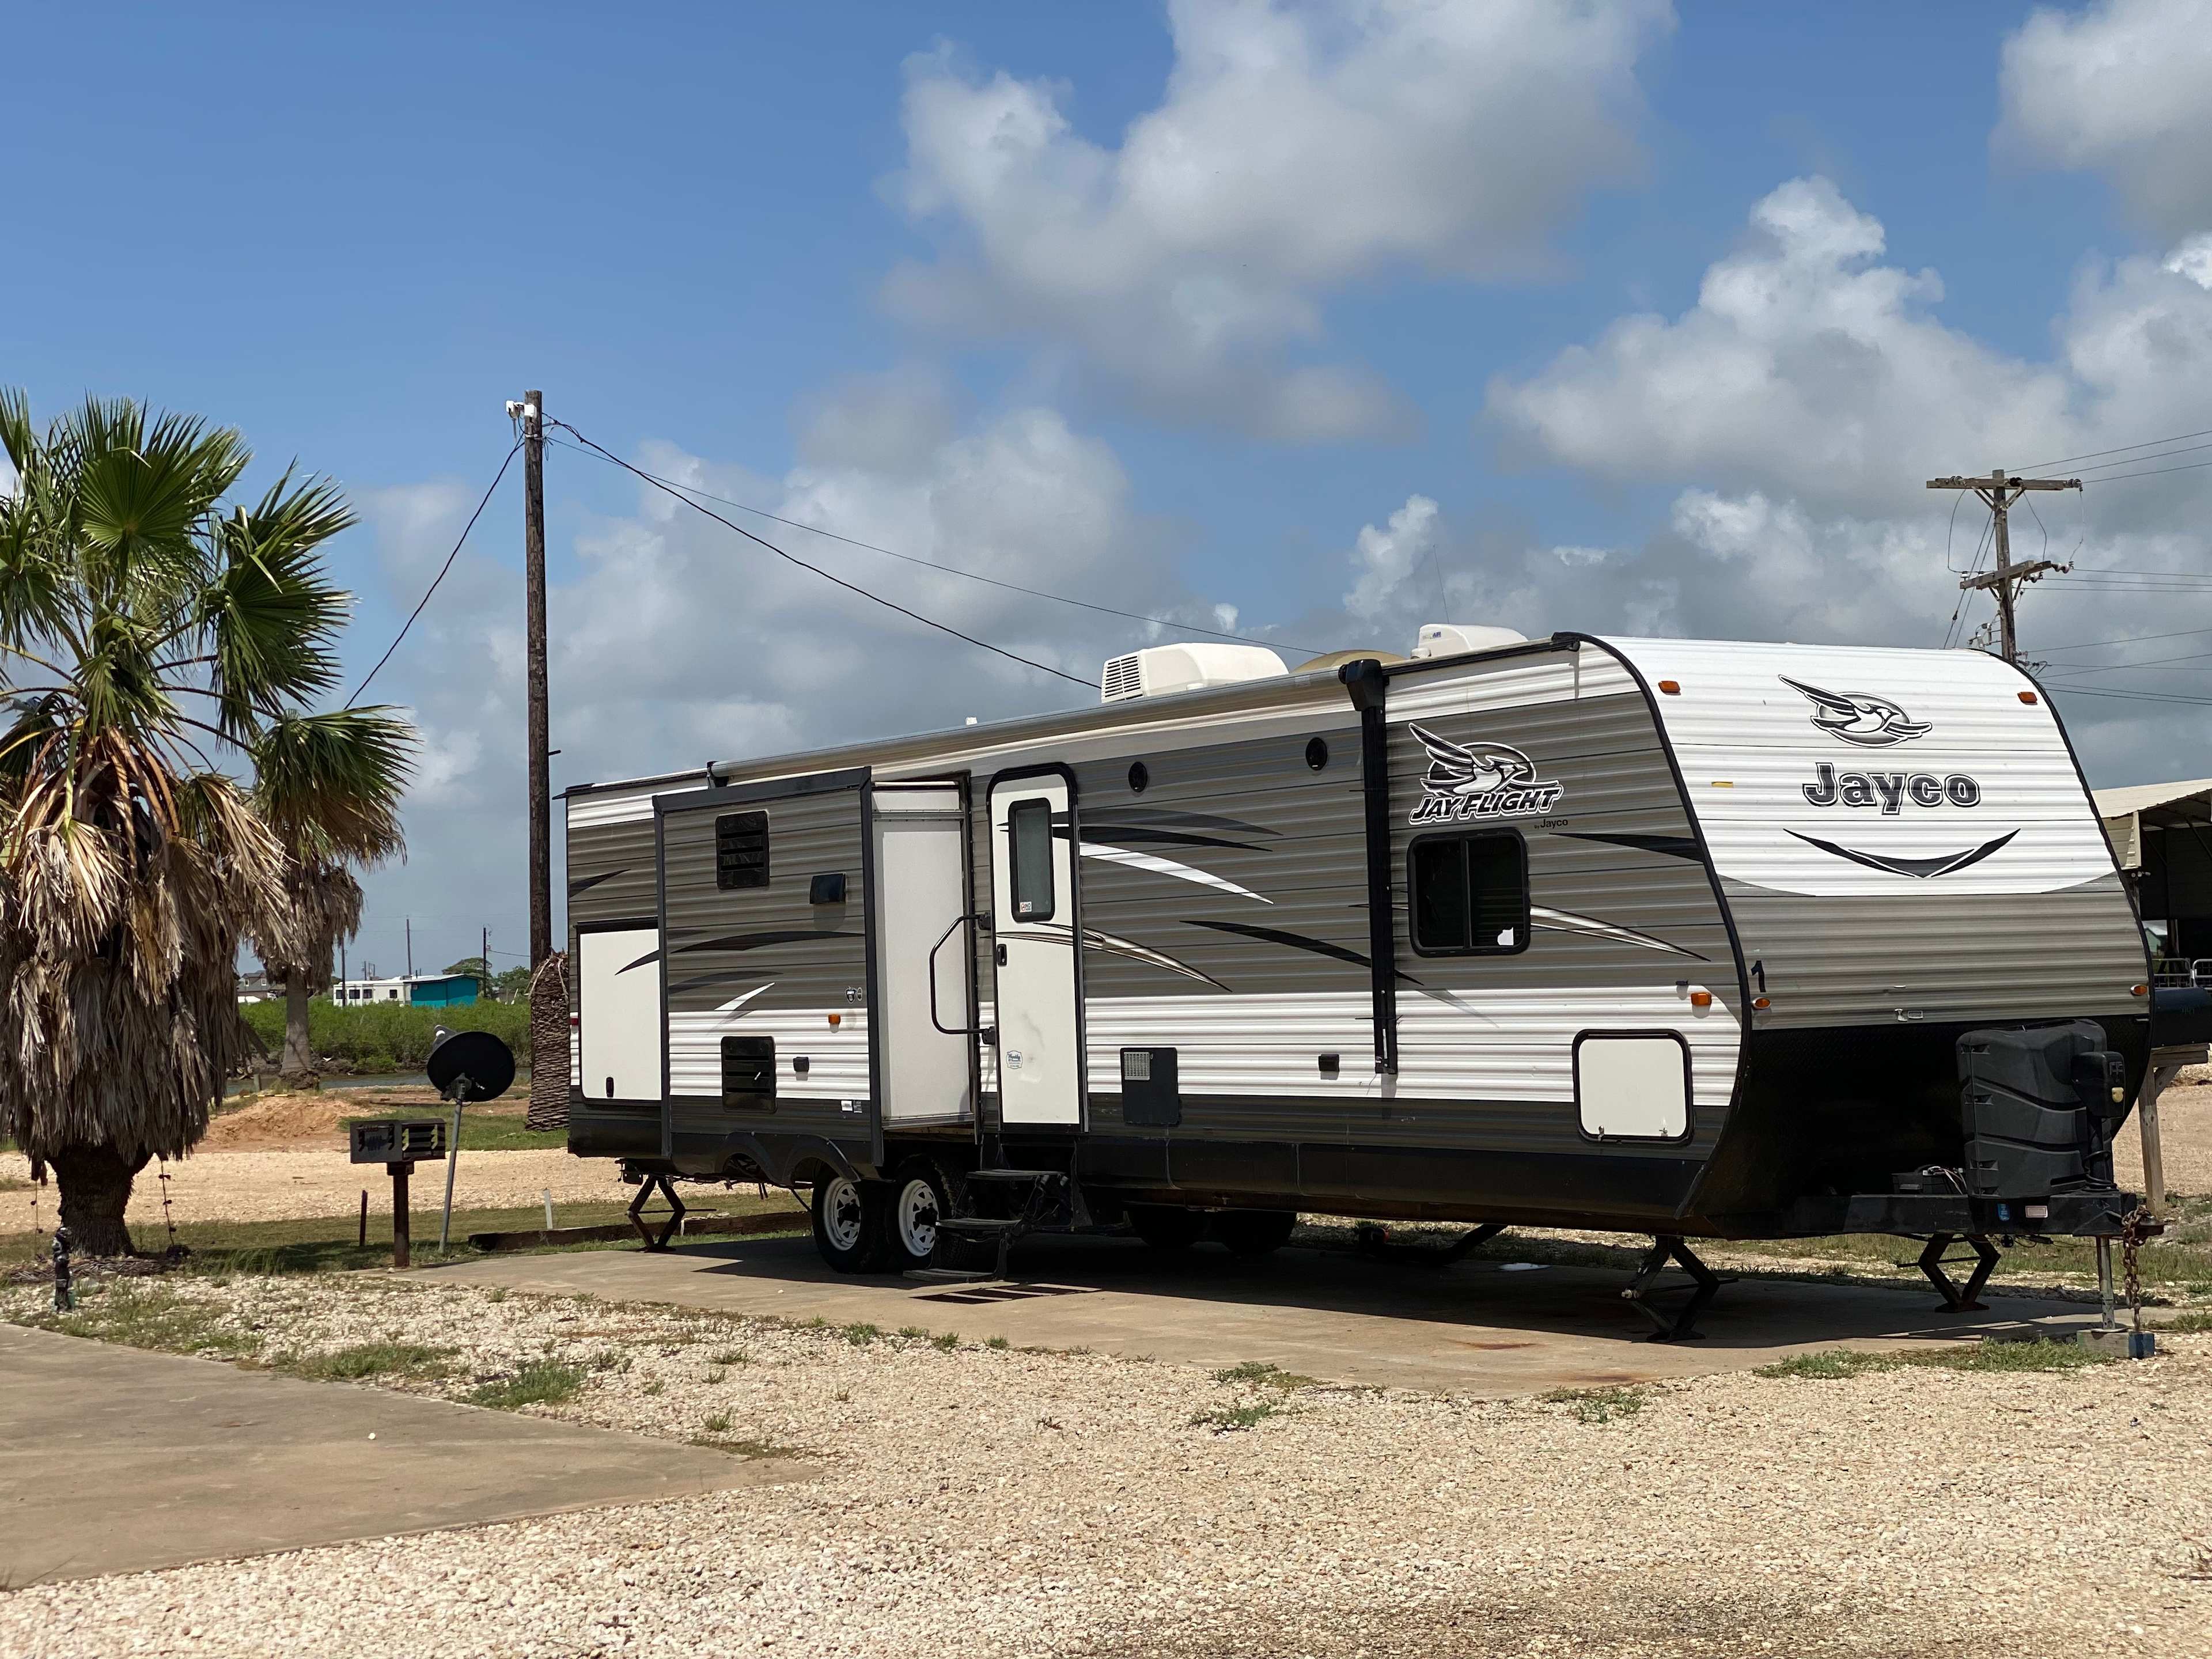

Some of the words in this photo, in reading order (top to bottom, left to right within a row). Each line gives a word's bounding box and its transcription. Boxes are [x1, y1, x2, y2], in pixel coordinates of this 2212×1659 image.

[1409, 795, 1463, 825] JAY
[1458, 785, 1564, 820] FLIGHT
[1802, 762, 1980, 815] Jayco
[1540, 819, 1568, 829] Jayco
[1751, 960, 1766, 993] 1
